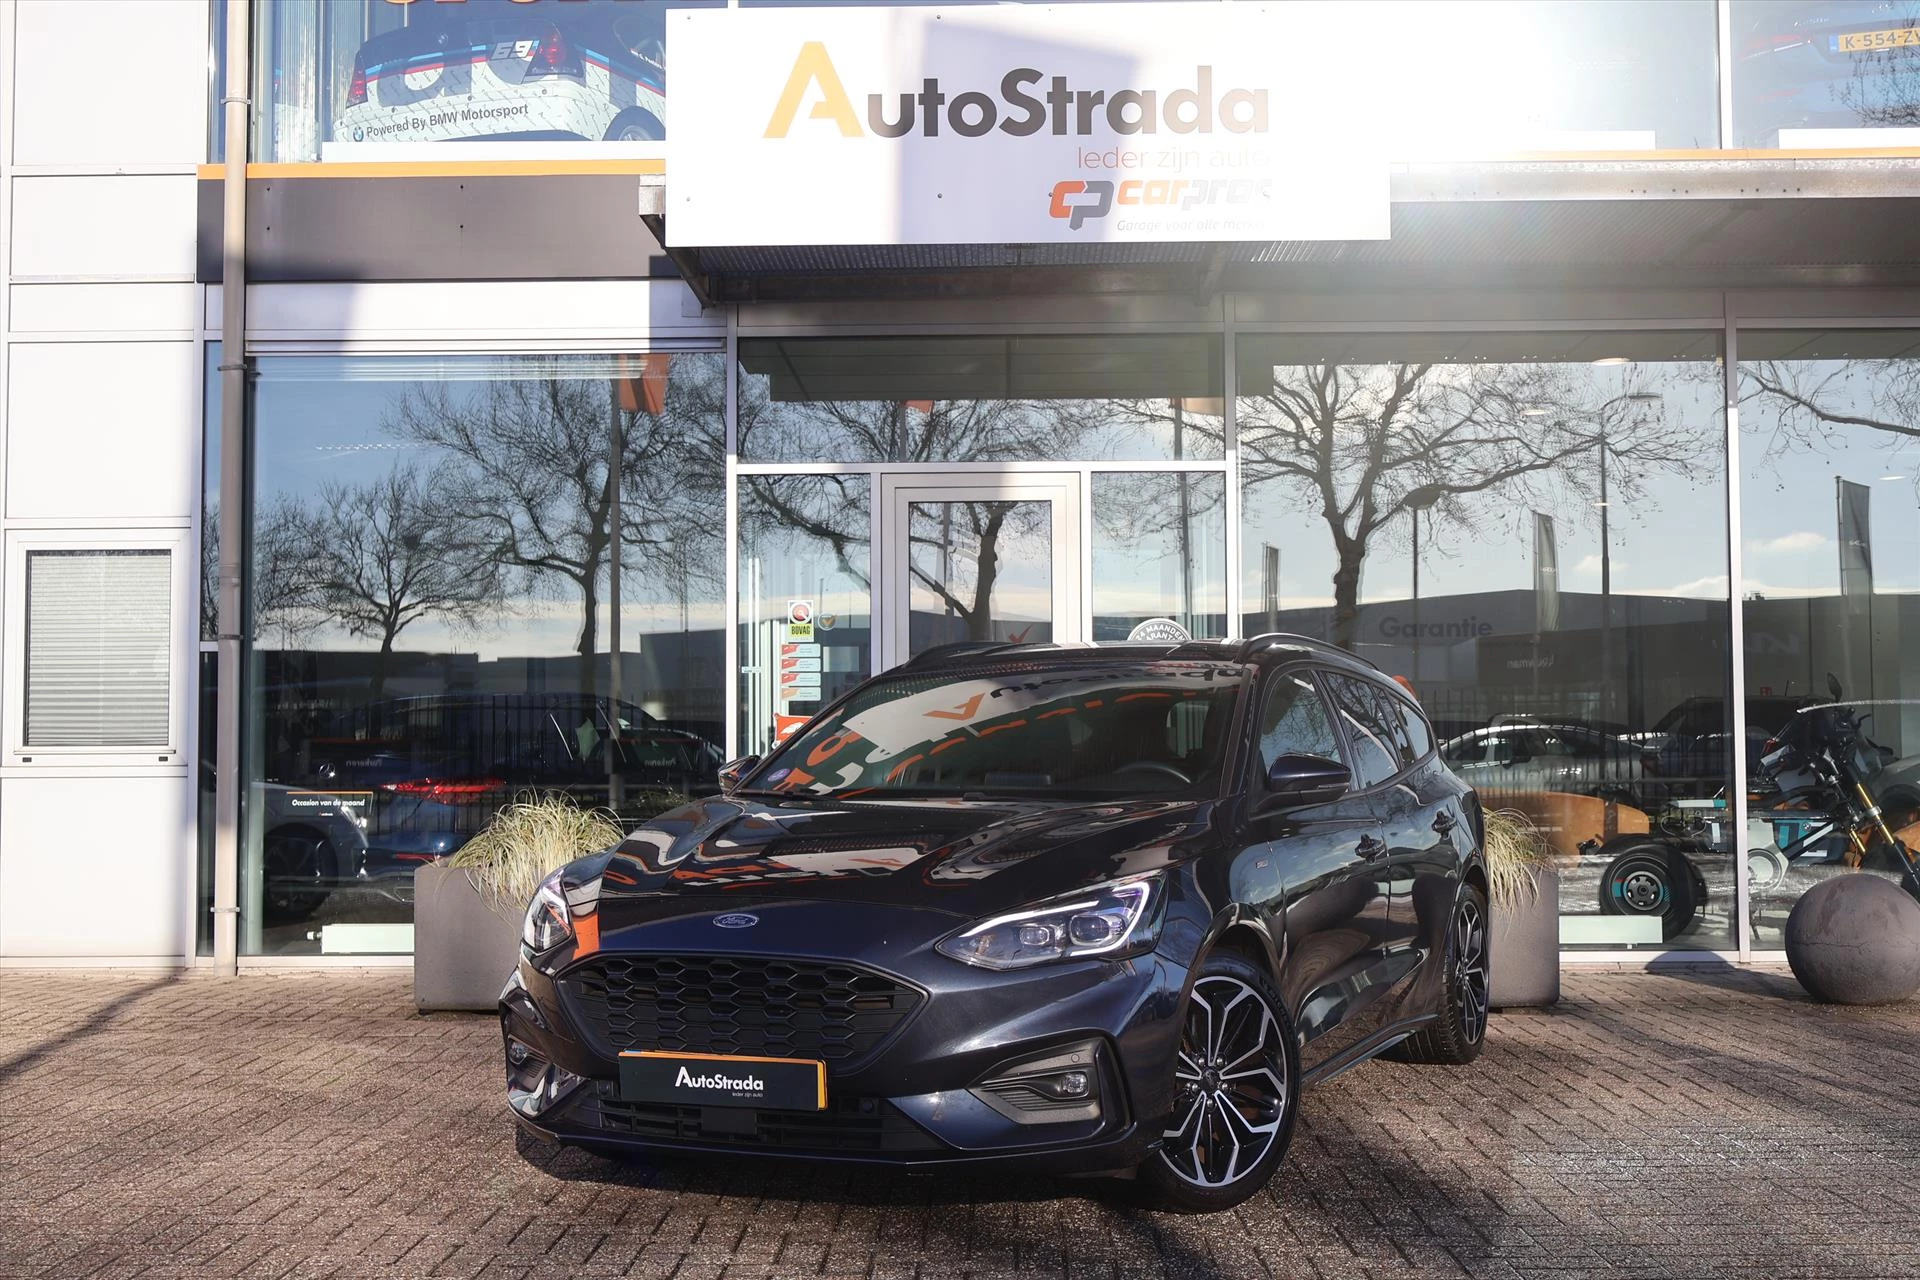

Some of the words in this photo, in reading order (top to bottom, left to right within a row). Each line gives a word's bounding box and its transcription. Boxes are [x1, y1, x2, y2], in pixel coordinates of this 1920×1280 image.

[762, 41, 1269, 138] AutoStrada
[366, 120, 409, 138] Powered
[412, 118, 427, 131] By
[429, 112, 458, 126] BMW
[461, 103, 529, 122] Motorsport
[1078, 147, 1146, 169] Ieder
[1158, 147, 1200, 173] zijn
[791, 625, 811, 635] BOVAG
[1379, 616, 1493, 638] Garantie
[291, 799, 319, 807] Occasion
[674, 1066, 764, 1092] AutoStrada
